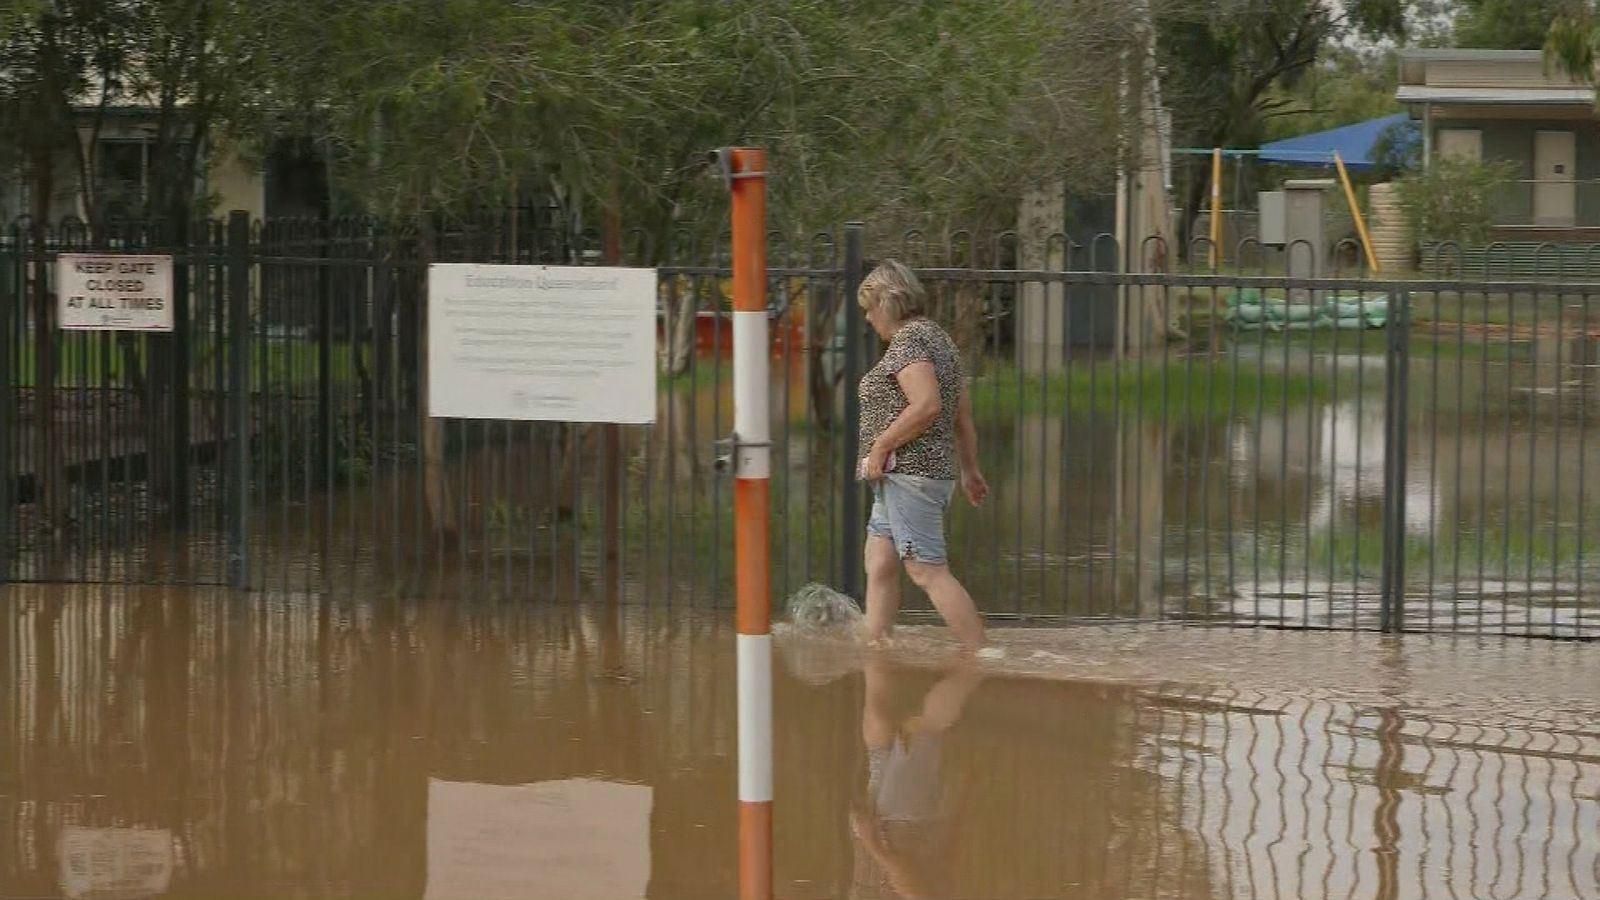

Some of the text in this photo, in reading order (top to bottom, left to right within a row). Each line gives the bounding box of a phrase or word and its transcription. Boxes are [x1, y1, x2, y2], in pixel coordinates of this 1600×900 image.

[76, 261, 156, 275] KEEP GATE
[86, 279, 145, 292] CLOSED
[67, 296, 165, 310] AT ALL TIMES
